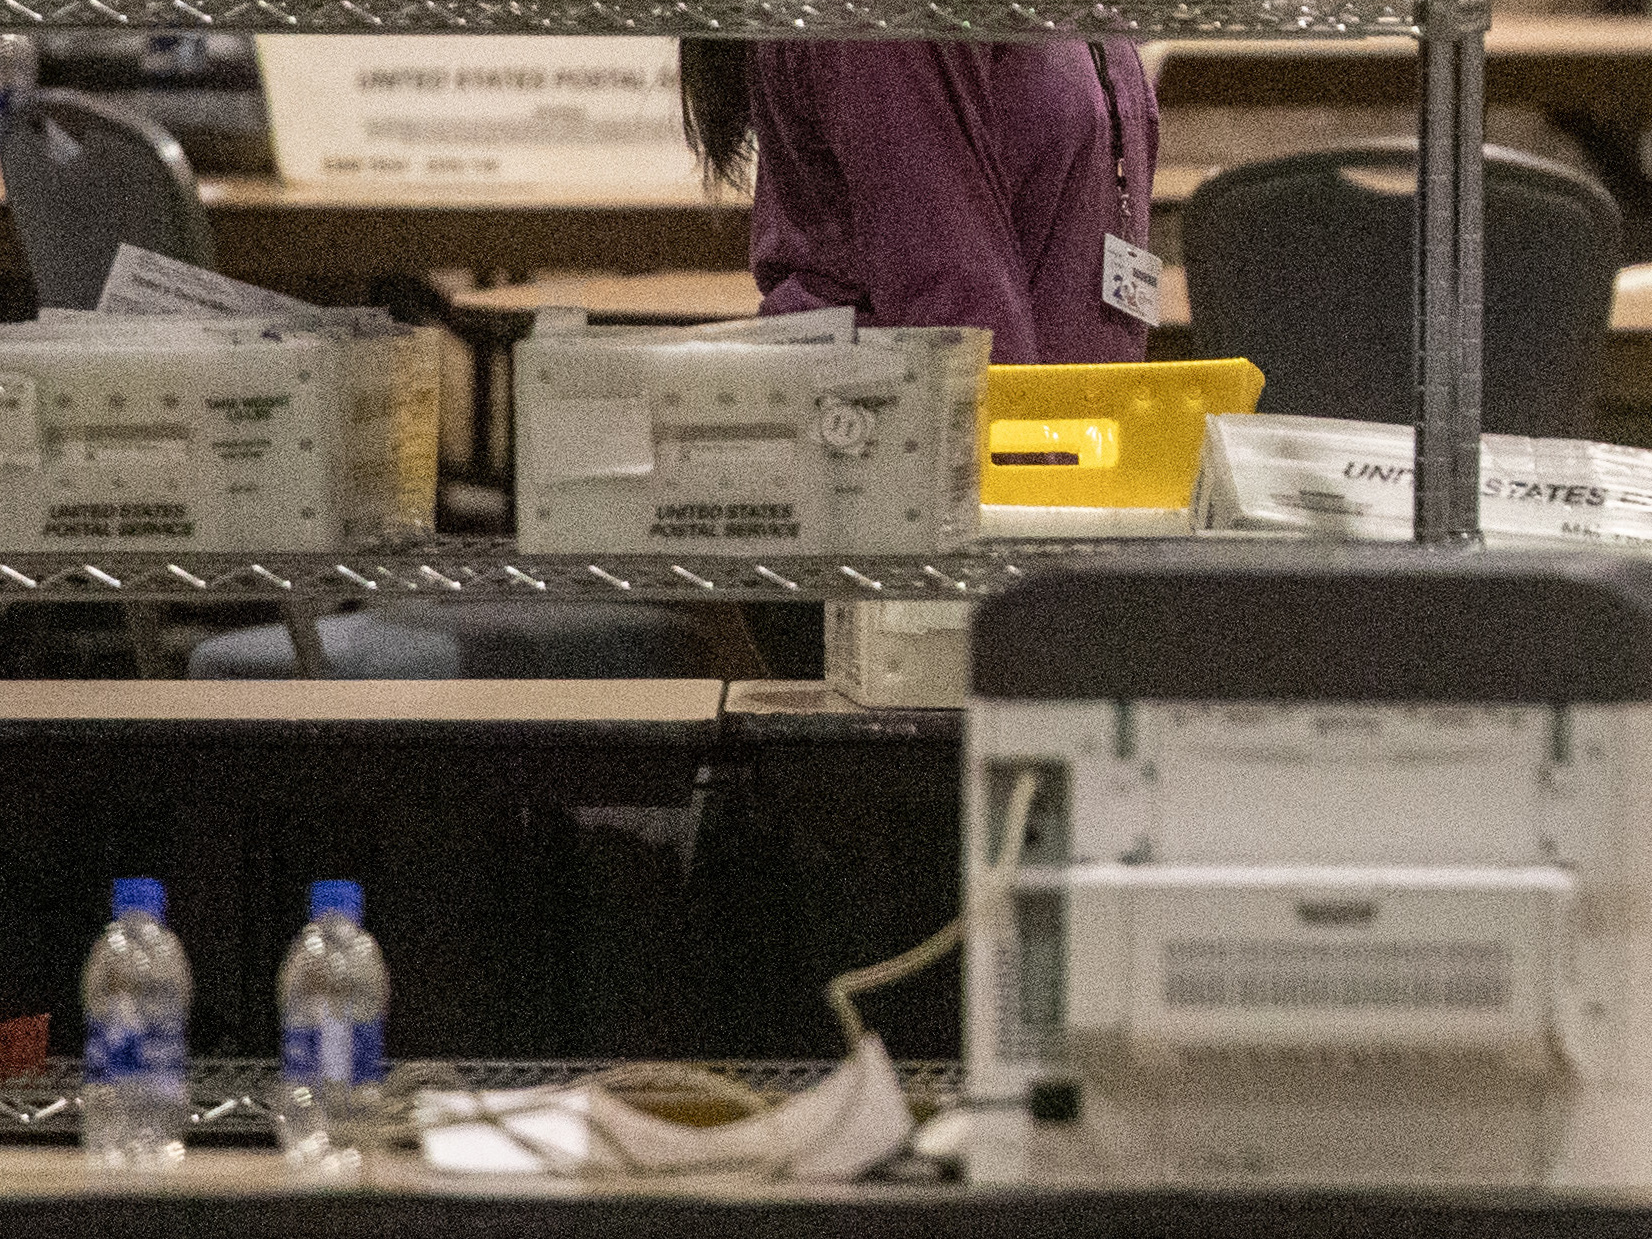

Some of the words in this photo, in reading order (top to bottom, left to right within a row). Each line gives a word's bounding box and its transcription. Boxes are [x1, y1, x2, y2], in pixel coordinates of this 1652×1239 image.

[1483, 476, 1606, 509] STATES
[50, 504, 117, 520] UNITED
[119, 503, 187, 519] STATES
[655, 505, 723, 520] UNITED
[727, 504, 793, 520] STATES
[43, 522, 111, 537] POSTAL
[118, 522, 195, 537] SERVICE
[650, 524, 721, 539] POSTAL
[726, 523, 800, 539] SERVICE
